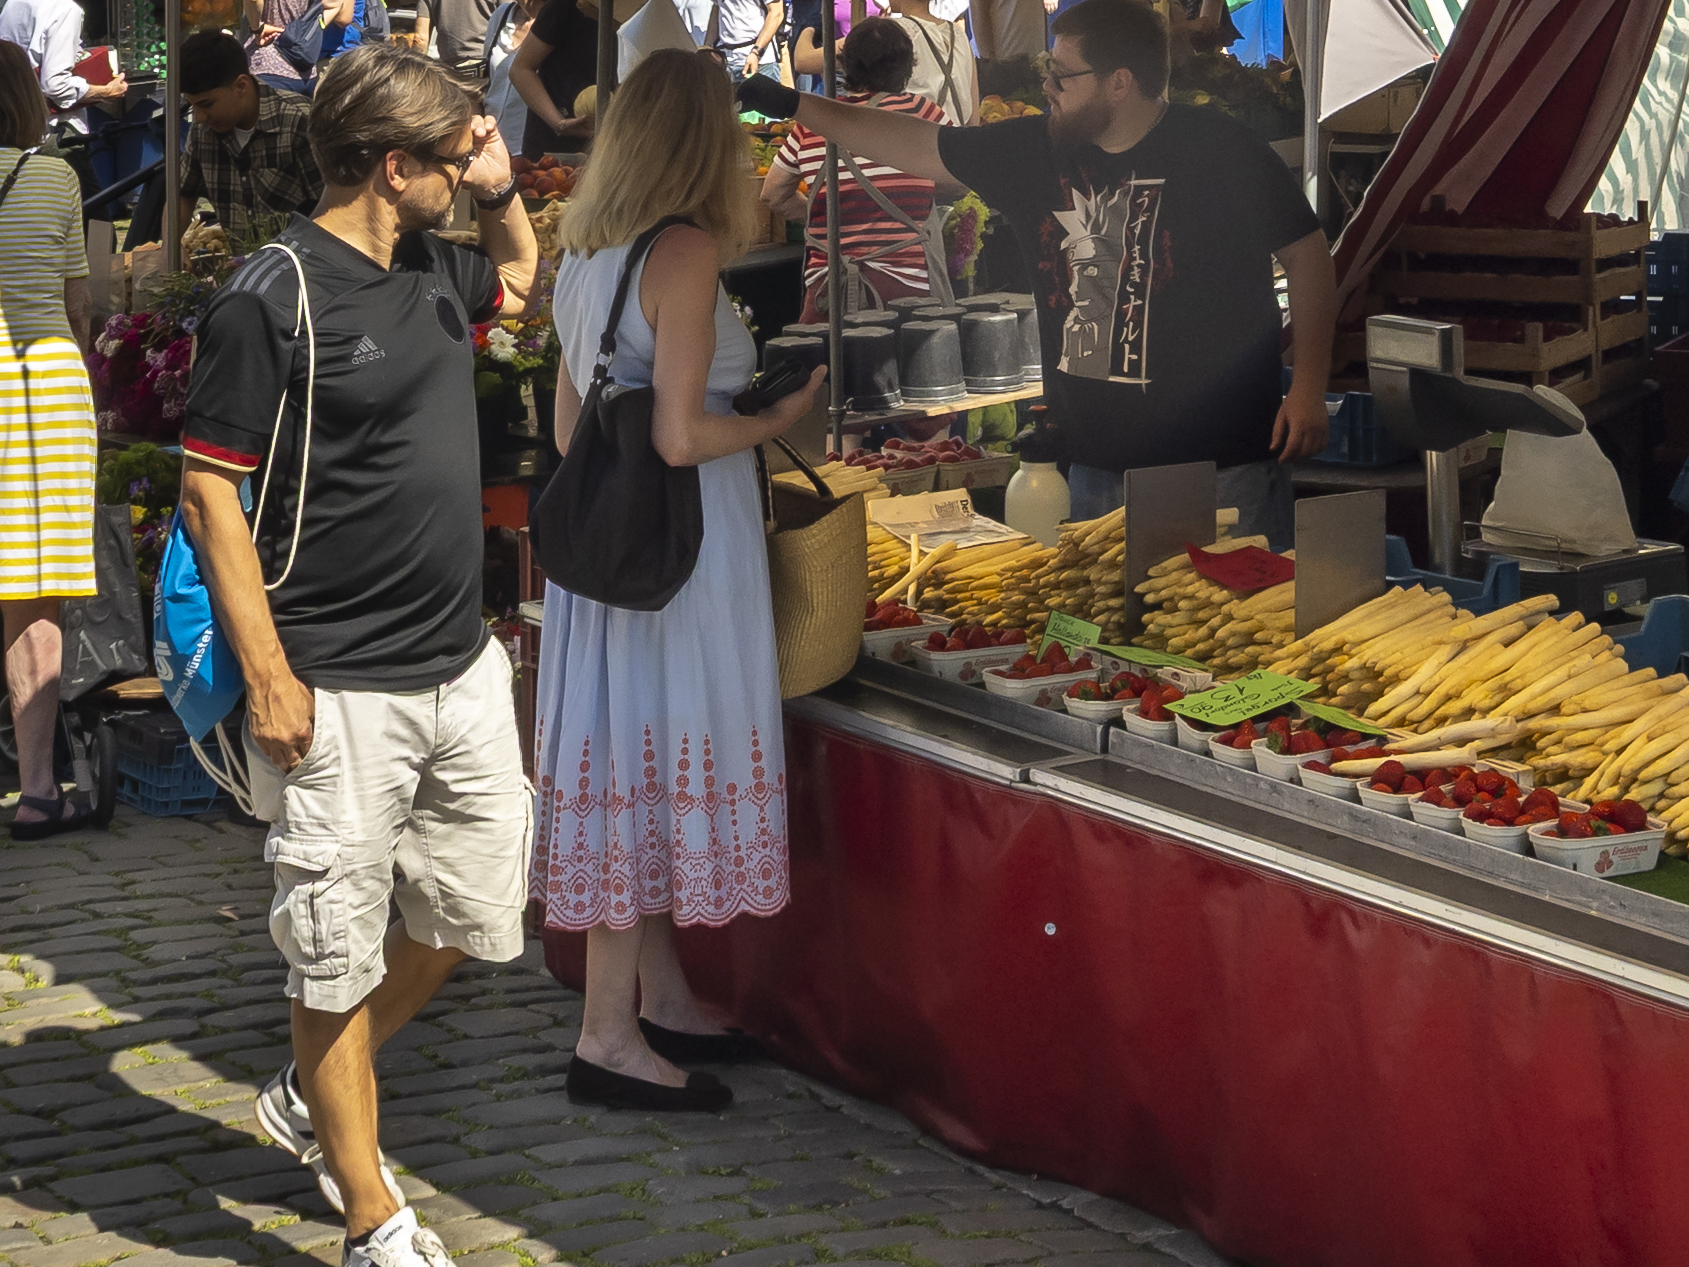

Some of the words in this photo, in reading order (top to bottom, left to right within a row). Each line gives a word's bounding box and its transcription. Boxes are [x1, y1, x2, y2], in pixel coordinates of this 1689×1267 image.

[352, 349, 385, 365] adidas
[183, 625, 214, 679] Münster
[383, 1224, 404, 1243] adidas
